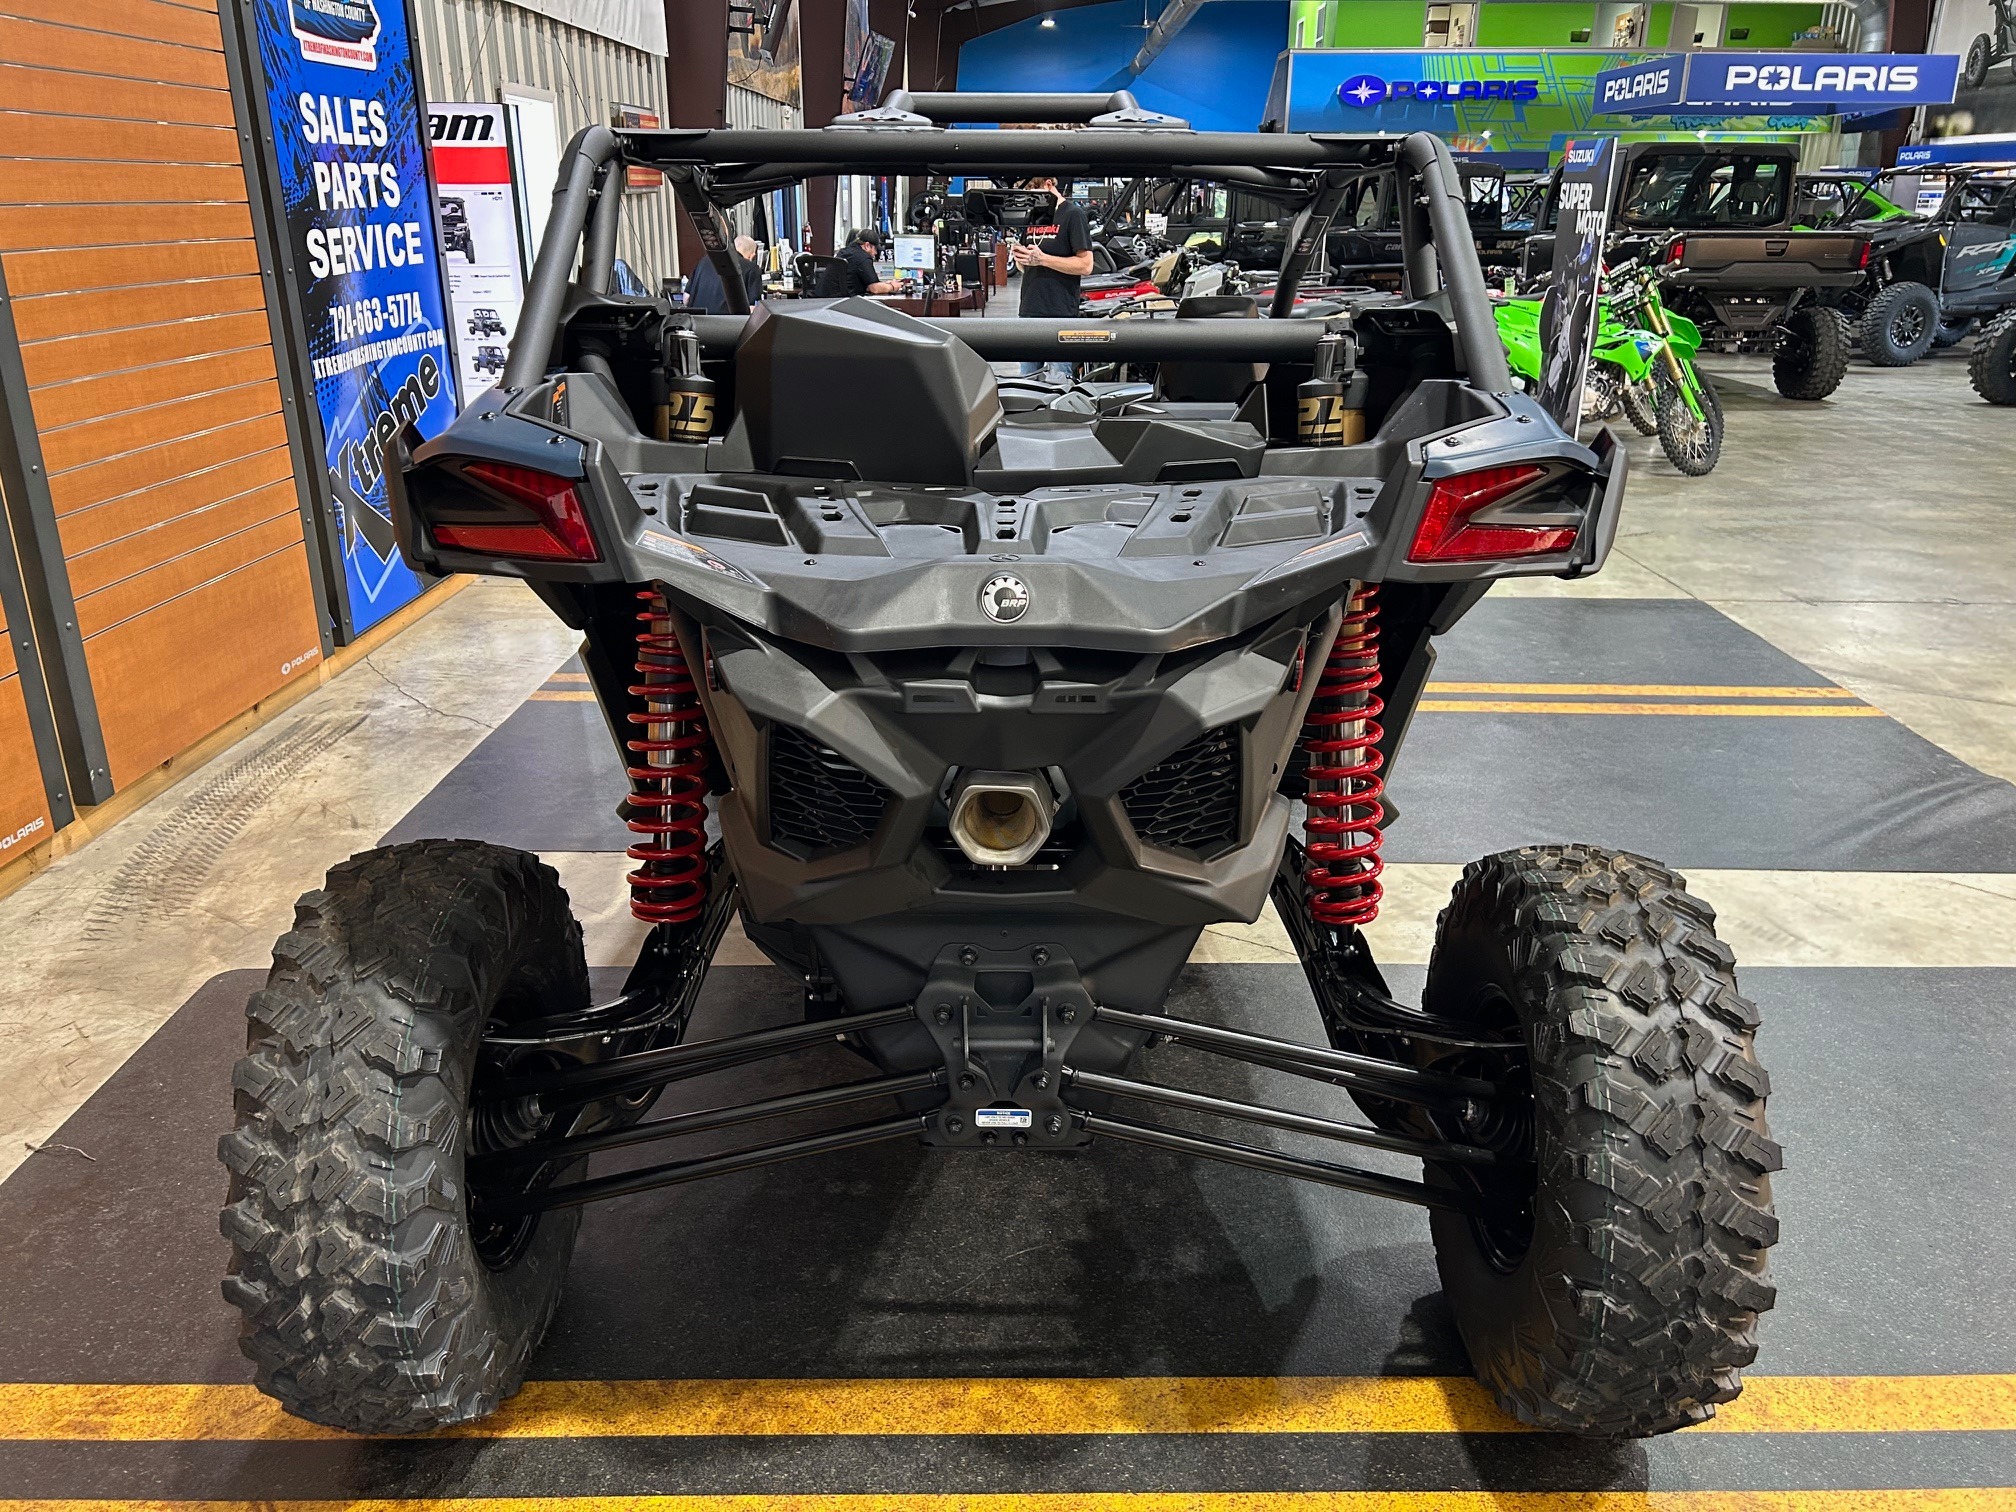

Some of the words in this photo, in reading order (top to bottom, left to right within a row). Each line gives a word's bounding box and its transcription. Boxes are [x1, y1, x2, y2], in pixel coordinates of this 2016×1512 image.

[312, 0, 345, 18] WASHINGTON
[344, 5, 366, 22] COUNTY
[1392, 80, 1539, 101] POLARIS
[1604, 69, 1670, 103] POLARIS
[1725, 65, 1919, 92] POLARIS
[299, 92, 388, 147] SALES
[1567, 149, 1595, 163] SUZUKI
[1900, 151, 1931, 161] POLARIS
[313, 161, 400, 211] PARTS
[1559, 183, 1593, 210] SUPER
[1575, 210, 1605, 237] MOTO
[306, 222, 424, 279] SERVICE
[329, 291, 423, 343] 724-663-5774
[330, 354, 439, 566] Xtreme
[1001, 599, 1026, 607] BRP
[291, 646, 319, 669] POLARIS
